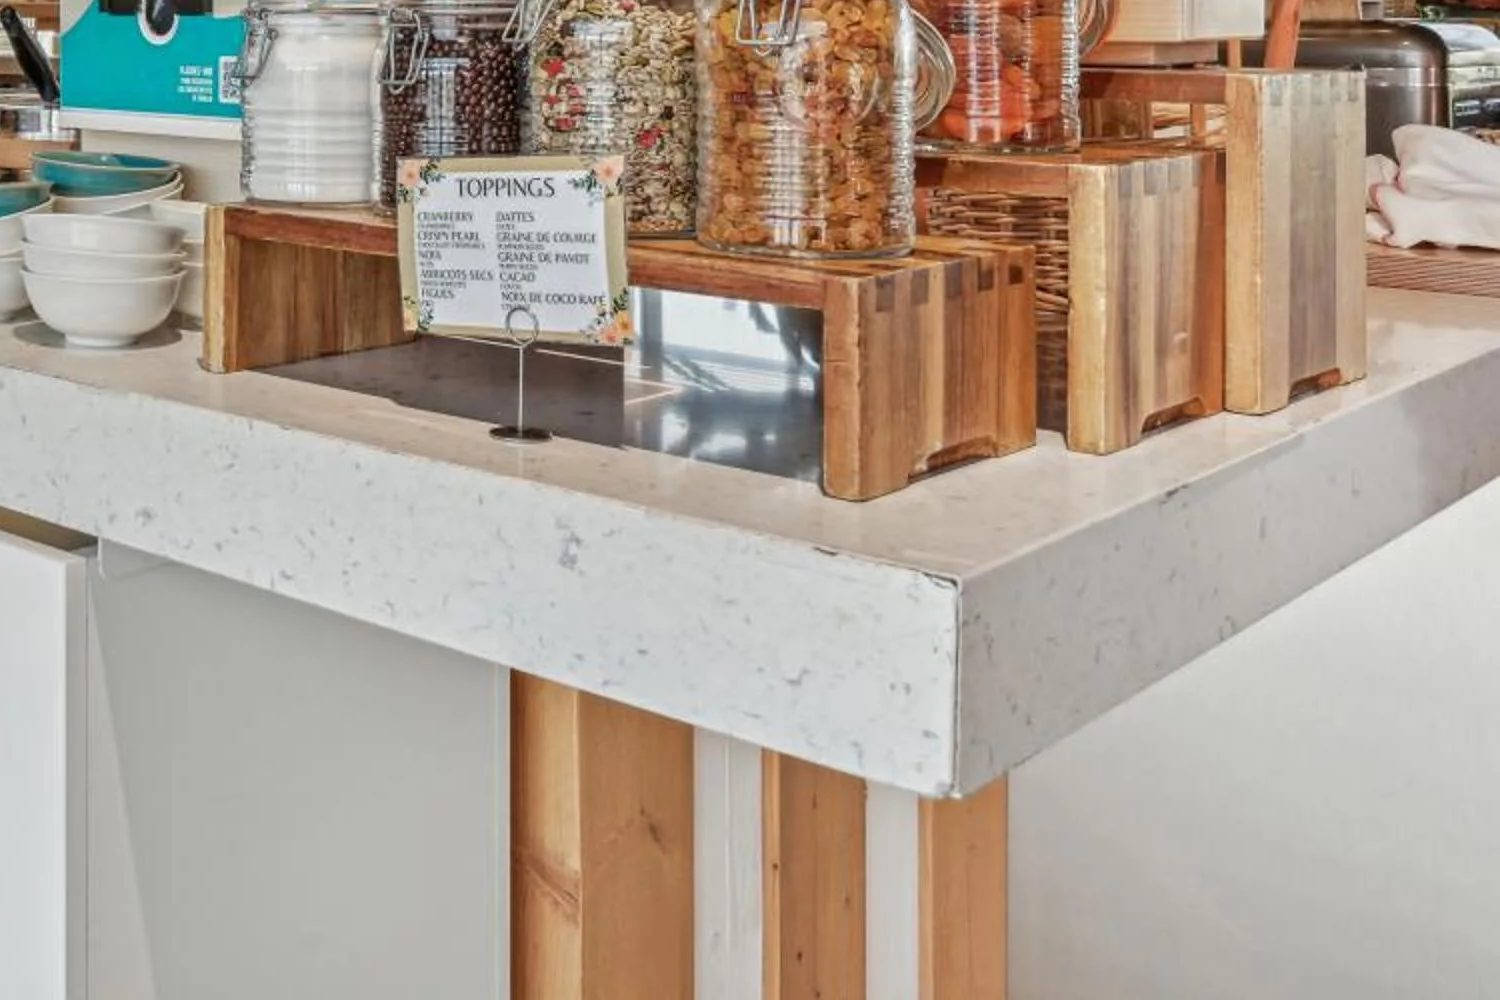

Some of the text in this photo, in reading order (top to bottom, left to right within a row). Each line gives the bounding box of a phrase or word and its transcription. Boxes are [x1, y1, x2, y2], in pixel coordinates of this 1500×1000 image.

[456, 177, 555, 198] TOPPINGS
[496, 211, 535, 223] DATTES
[496, 231, 534, 243] GRAINE
[536, 231, 551, 243] DE
[497, 251, 534, 263] GRAINE
[537, 252, 552, 264] DE
[468, 269, 494, 281] SECS
[499, 272, 536, 283] CACAO
[501, 291, 527, 303] NOIX
[529, 292, 543, 304] DE
[545, 293, 577, 305] COCO
